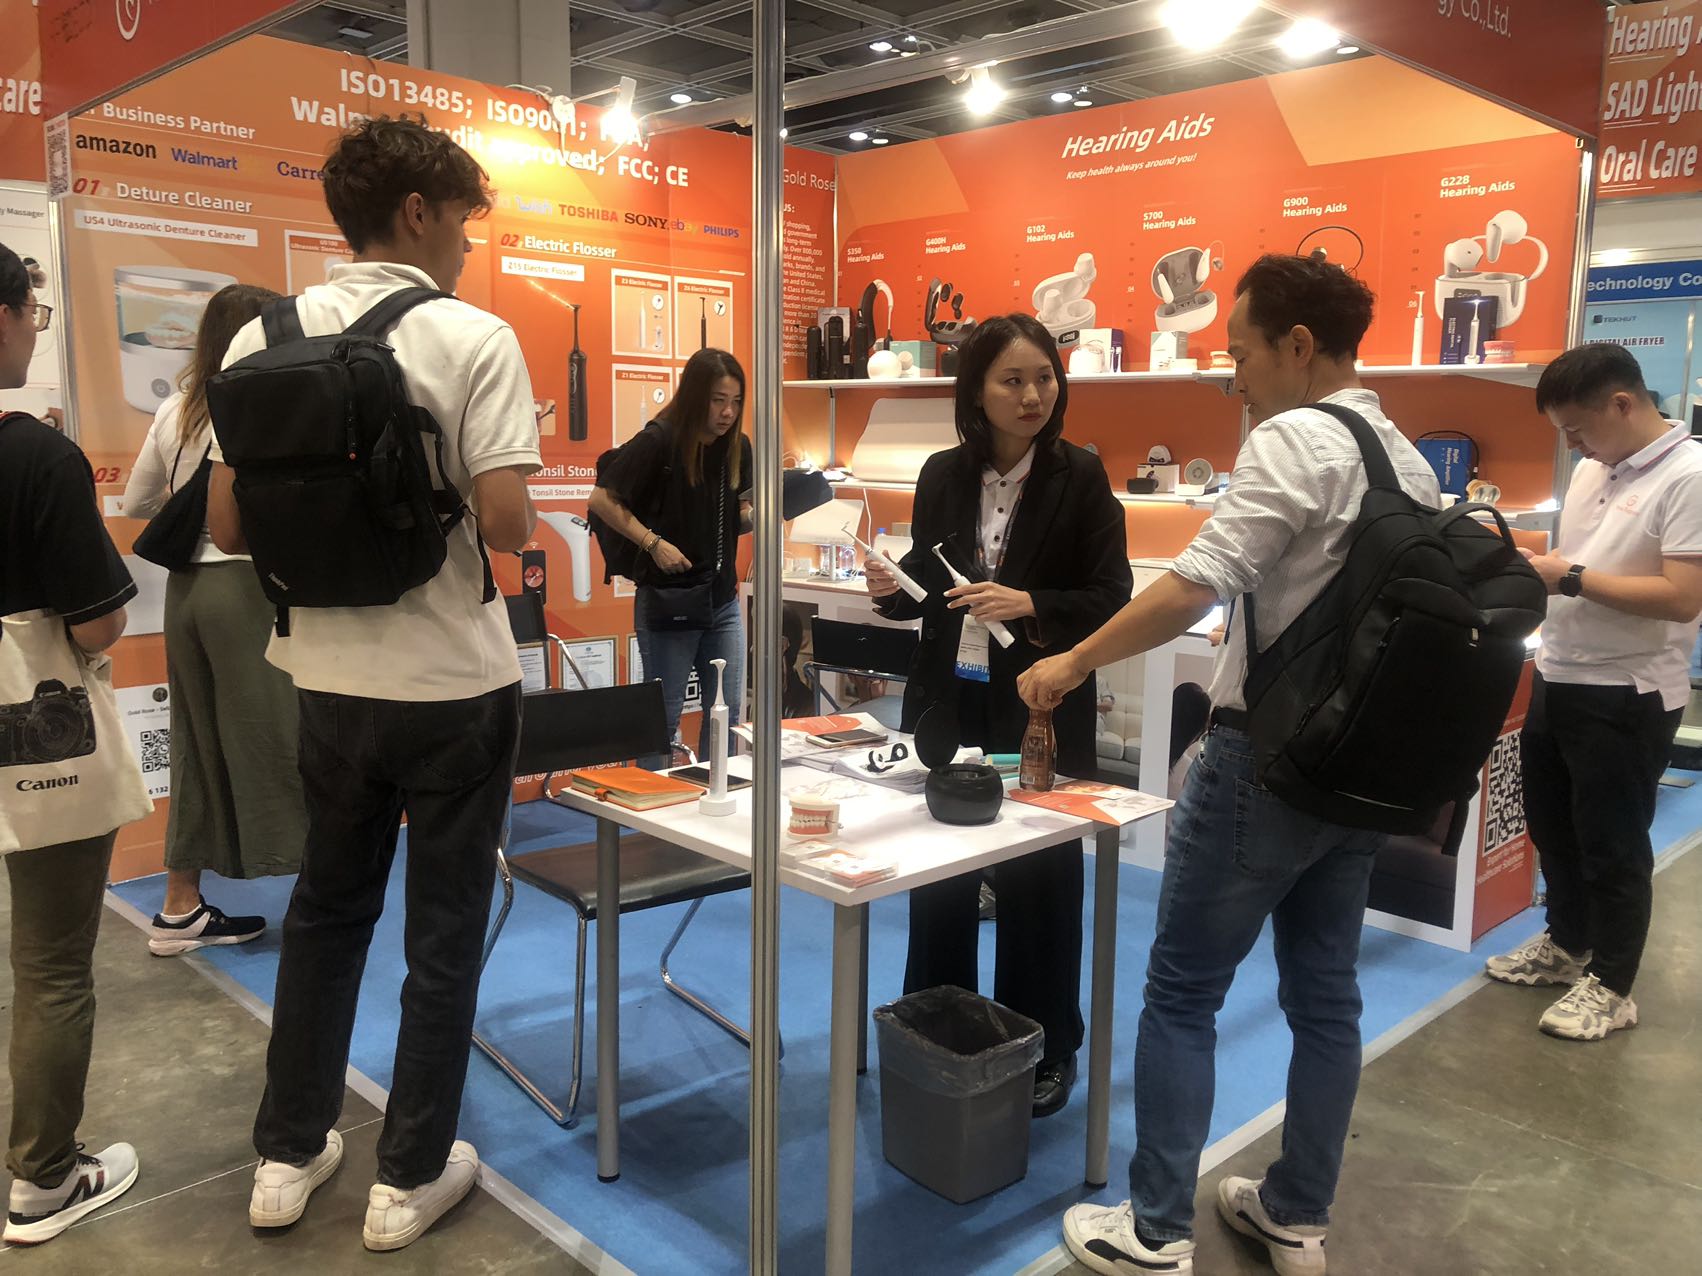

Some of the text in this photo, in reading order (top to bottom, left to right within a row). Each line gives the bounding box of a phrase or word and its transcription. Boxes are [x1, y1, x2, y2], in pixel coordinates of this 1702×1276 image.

[1609, 6, 1694, 57] Hearing
[0, 77, 42, 115] are
[340, 68, 473, 119] ISO13485;
[487, 98, 587, 141] ISO901;
[1603, 79, 1648, 121] SAD
[103, 102, 256, 140] Business Partner
[1061, 112, 1215, 159] Hearing Aids
[1066, 153, 1198, 180] Keep health always around you!
[1599, 139, 1697, 184] Oral Care
[618, 155, 659, 185] FCC;
[665, 165, 689, 187] CE
[75, 133, 157, 159] amazon
[171, 147, 238, 170] Walmart
[276, 161, 325, 181] Carre
[558, 203, 619, 223] TOSHIBA
[703, 224, 740, 239] PHILIPS
[1440, 175, 1470, 187] G228
[1440, 180, 1516, 198] Hearing Aids
[72, 177, 252, 213] 01 Deture Cleaner
[1283, 196, 1309, 208] G900
[1143, 210, 1163, 221] S700
[1283, 201, 1348, 218] Hearing Aids
[107, 216, 161, 233] Ultrasonic
[164, 224, 205, 237] Denture
[207, 228, 247, 242] Cleaner
[1026, 224, 1046, 234] G102
[1143, 215, 1197, 231] Hearing Aids
[1026, 230, 1075, 243] Hearing Aids
[500, 233, 617, 259] 02 Electric Flosser
[925, 242, 966, 254] Hearing Aids
[847, 252, 885, 263] Hearing Aids
[1587, 275, 1674, 291] echnology
[1623, 338, 1637, 346] AIR
[1638, 336, 1664, 346] FRYER
[96, 467, 120, 483] 03
[531, 464, 597, 477] onsil Ston
[532, 488, 554, 496] Tonsil
[15, 774, 79, 792] Canon
